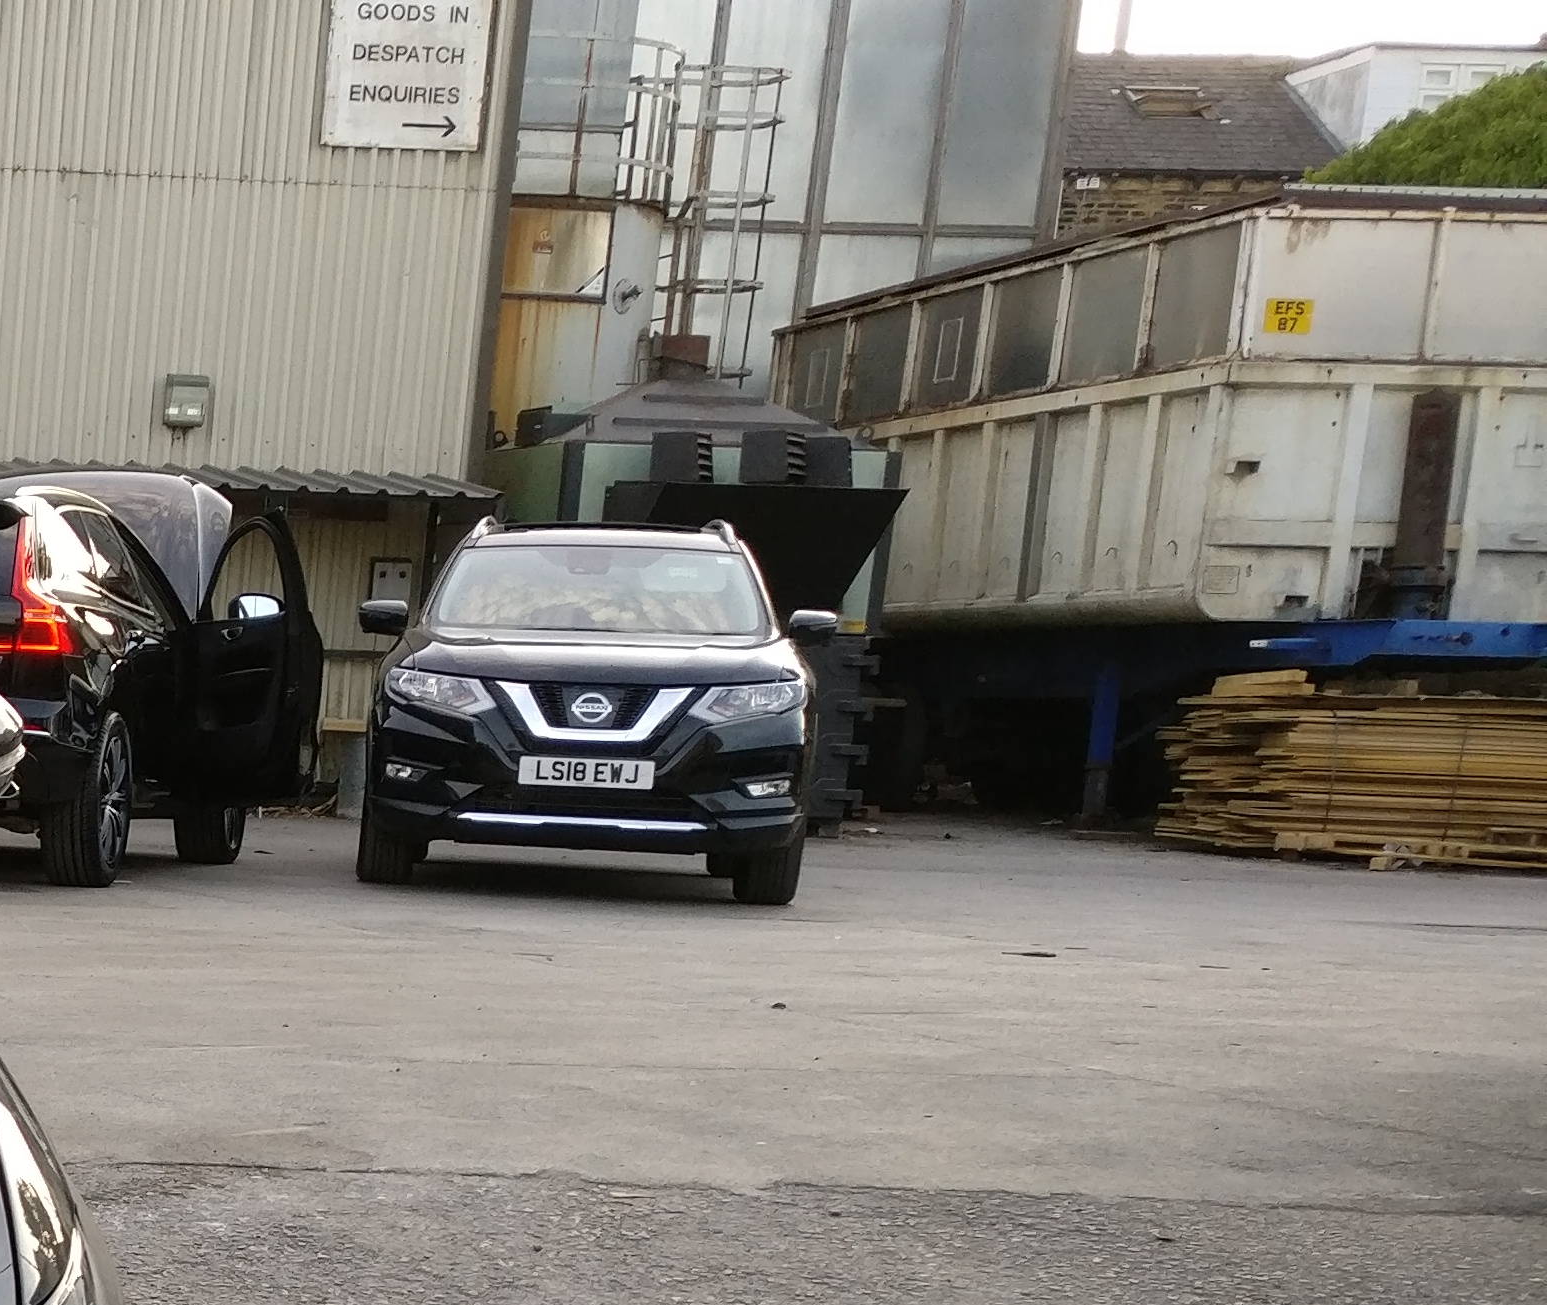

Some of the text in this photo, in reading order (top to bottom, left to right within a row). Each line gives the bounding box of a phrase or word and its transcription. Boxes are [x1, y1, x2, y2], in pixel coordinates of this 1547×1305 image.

[357, 2, 469, 24] GOODS IN
[352, 43, 466, 65] DESPATCH
[349, 84, 460, 105] ENQUIRIES
[1277, 317, 1299, 332] 87
[535, 760, 640, 784] LS18 EWJ
